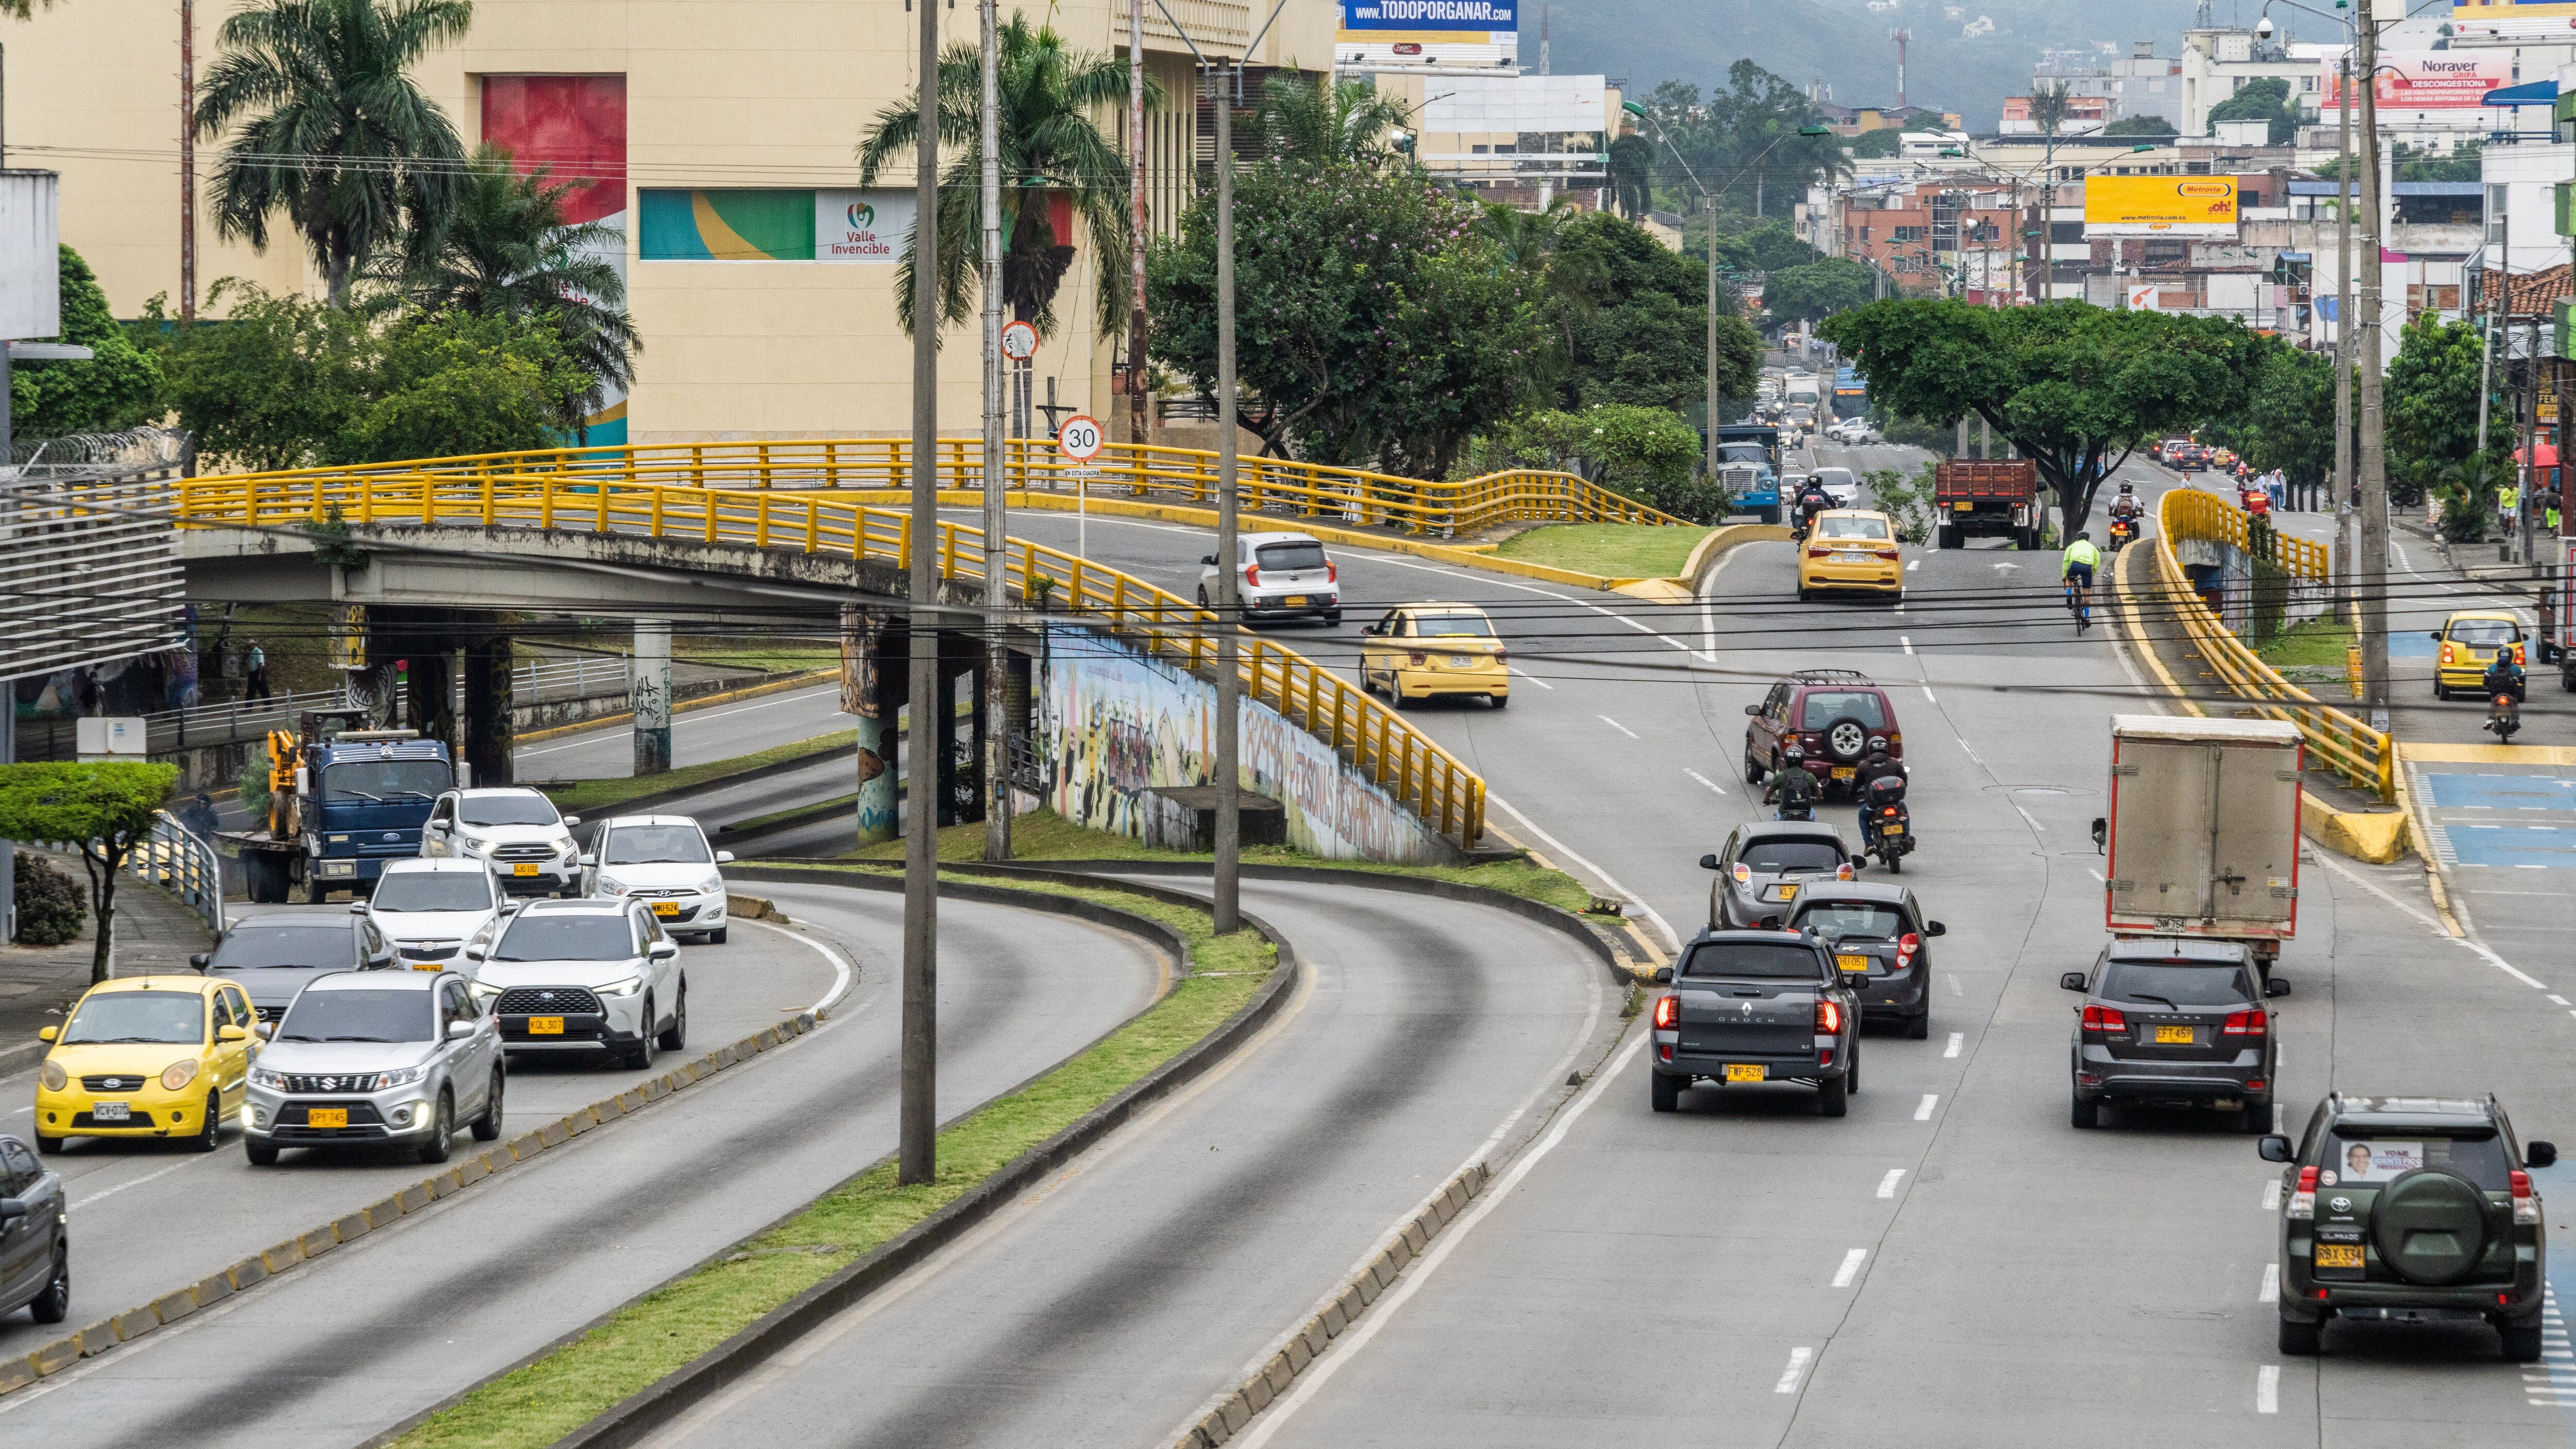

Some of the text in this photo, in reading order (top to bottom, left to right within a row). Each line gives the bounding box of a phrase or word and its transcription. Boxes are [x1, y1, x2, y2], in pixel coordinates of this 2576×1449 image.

[2422, 60, 2477, 72] Noraver
[846, 230, 876, 243] Valle
[832, 243, 890, 254] Invencible
[1070, 429, 1095, 448] 30
